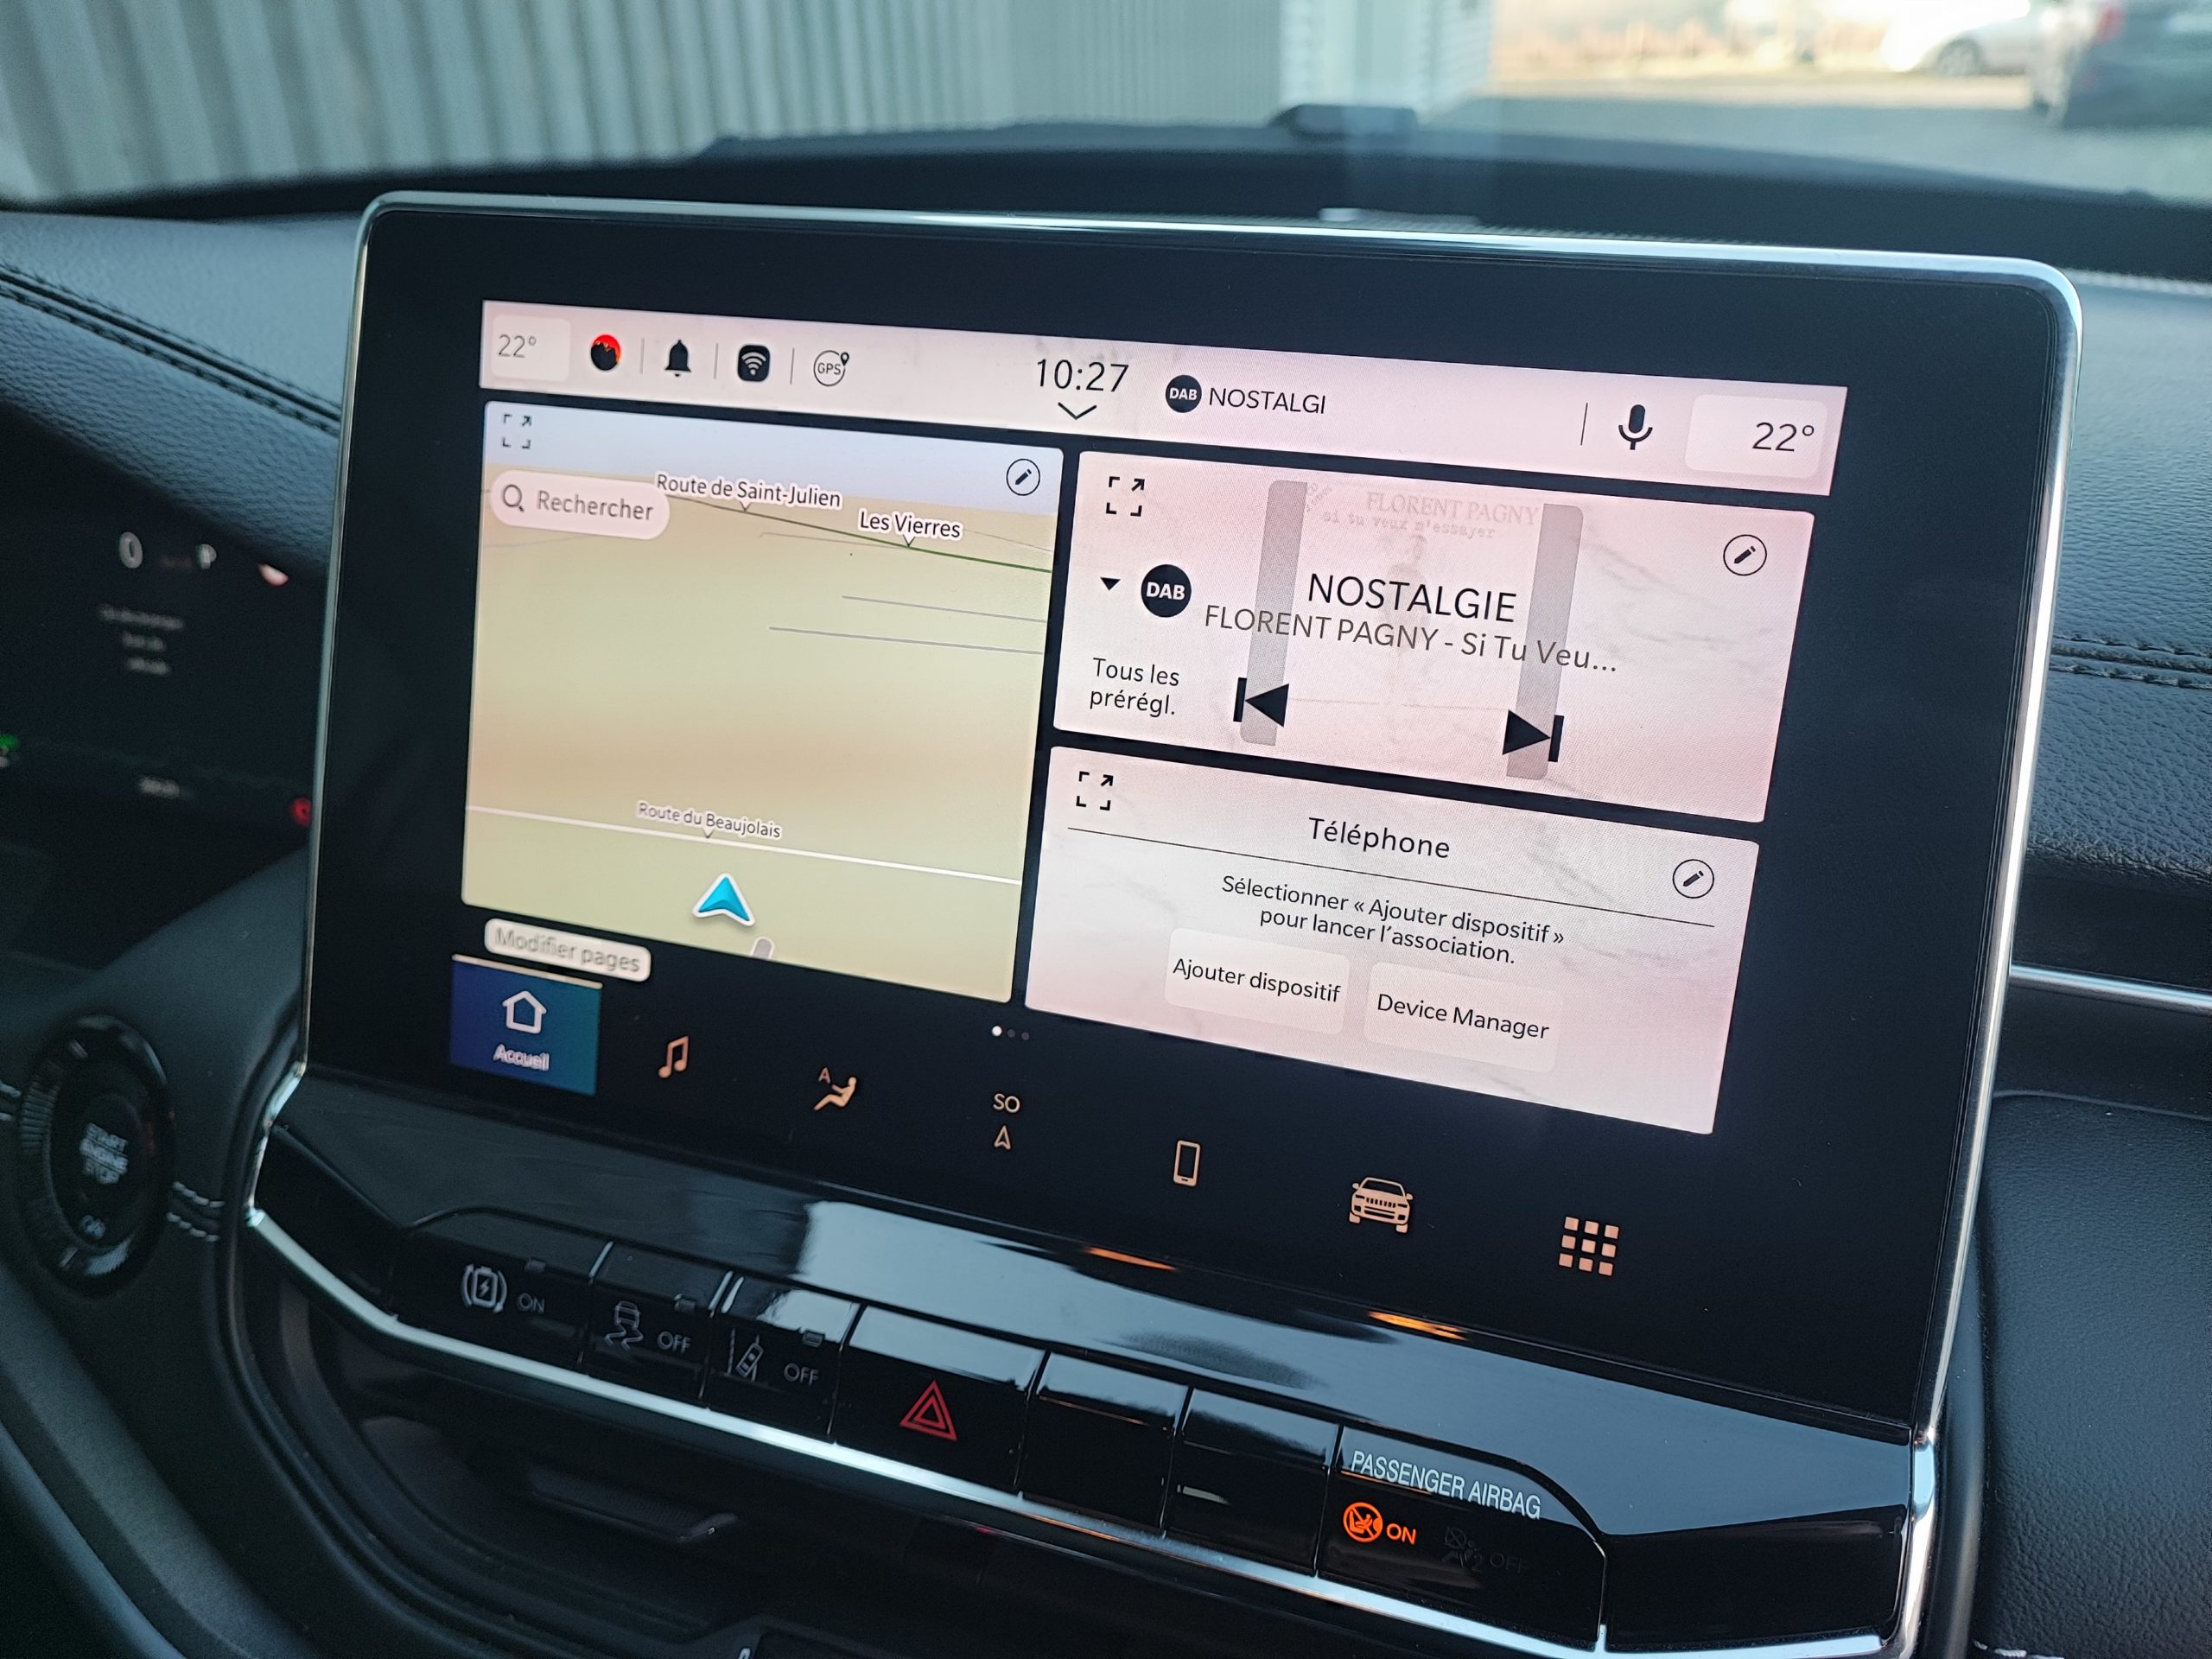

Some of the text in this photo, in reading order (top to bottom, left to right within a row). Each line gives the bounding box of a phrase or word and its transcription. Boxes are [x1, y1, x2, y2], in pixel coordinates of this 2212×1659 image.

[816, 361, 842, 377] GPS
[1035, 359, 1128, 394] 10:27
[1169, 386, 1199, 402] DAB
[1209, 386, 1327, 416] NOSTALGI
[1751, 422, 1815, 454] 22°
[536, 489, 654, 522] Rechercher
[656, 474, 842, 509] Route de Saint-Julien
[1367, 491, 1541, 525] FLORENT PAGNY
[860, 510, 961, 540] Les Vierres
[1145, 581, 1186, 602] DAB
[1306, 572, 1518, 624] NOSTALGIE
[1204, 603, 1332, 641] FLORENT
[1336, 618, 1439, 653] PAGNY
[1461, 632, 1487, 658] Si
[1492, 634, 1528, 664] Tu
[1092, 657, 1180, 688] Tous les
[1089, 685, 1177, 719] prérégl.
[639, 802, 782, 839] Route du Beaujolais
[1307, 816, 1451, 861] Téléphone
[1221, 874, 1350, 914] Sélectionner
[1368, 898, 1446, 928] Ajouter
[1451, 908, 1552, 945] dispositif
[493, 925, 641, 973] Modifier pages
[1259, 907, 1516, 965] pour lancer l'association.
[1173, 956, 1343, 1005] Ajouter dispositif
[1376, 991, 1550, 1042] Device Manager
[493, 1042, 550, 1072] Accueil
[993, 1092, 1021, 1114] SO
[518, 1292, 546, 1315] ON
[657, 1330, 692, 1355] OFF
[783, 1362, 820, 1385] OFF
[1351, 1449, 1542, 1520] PASSENGER AIRBAG
[1386, 1522, 1417, 1546] ON
